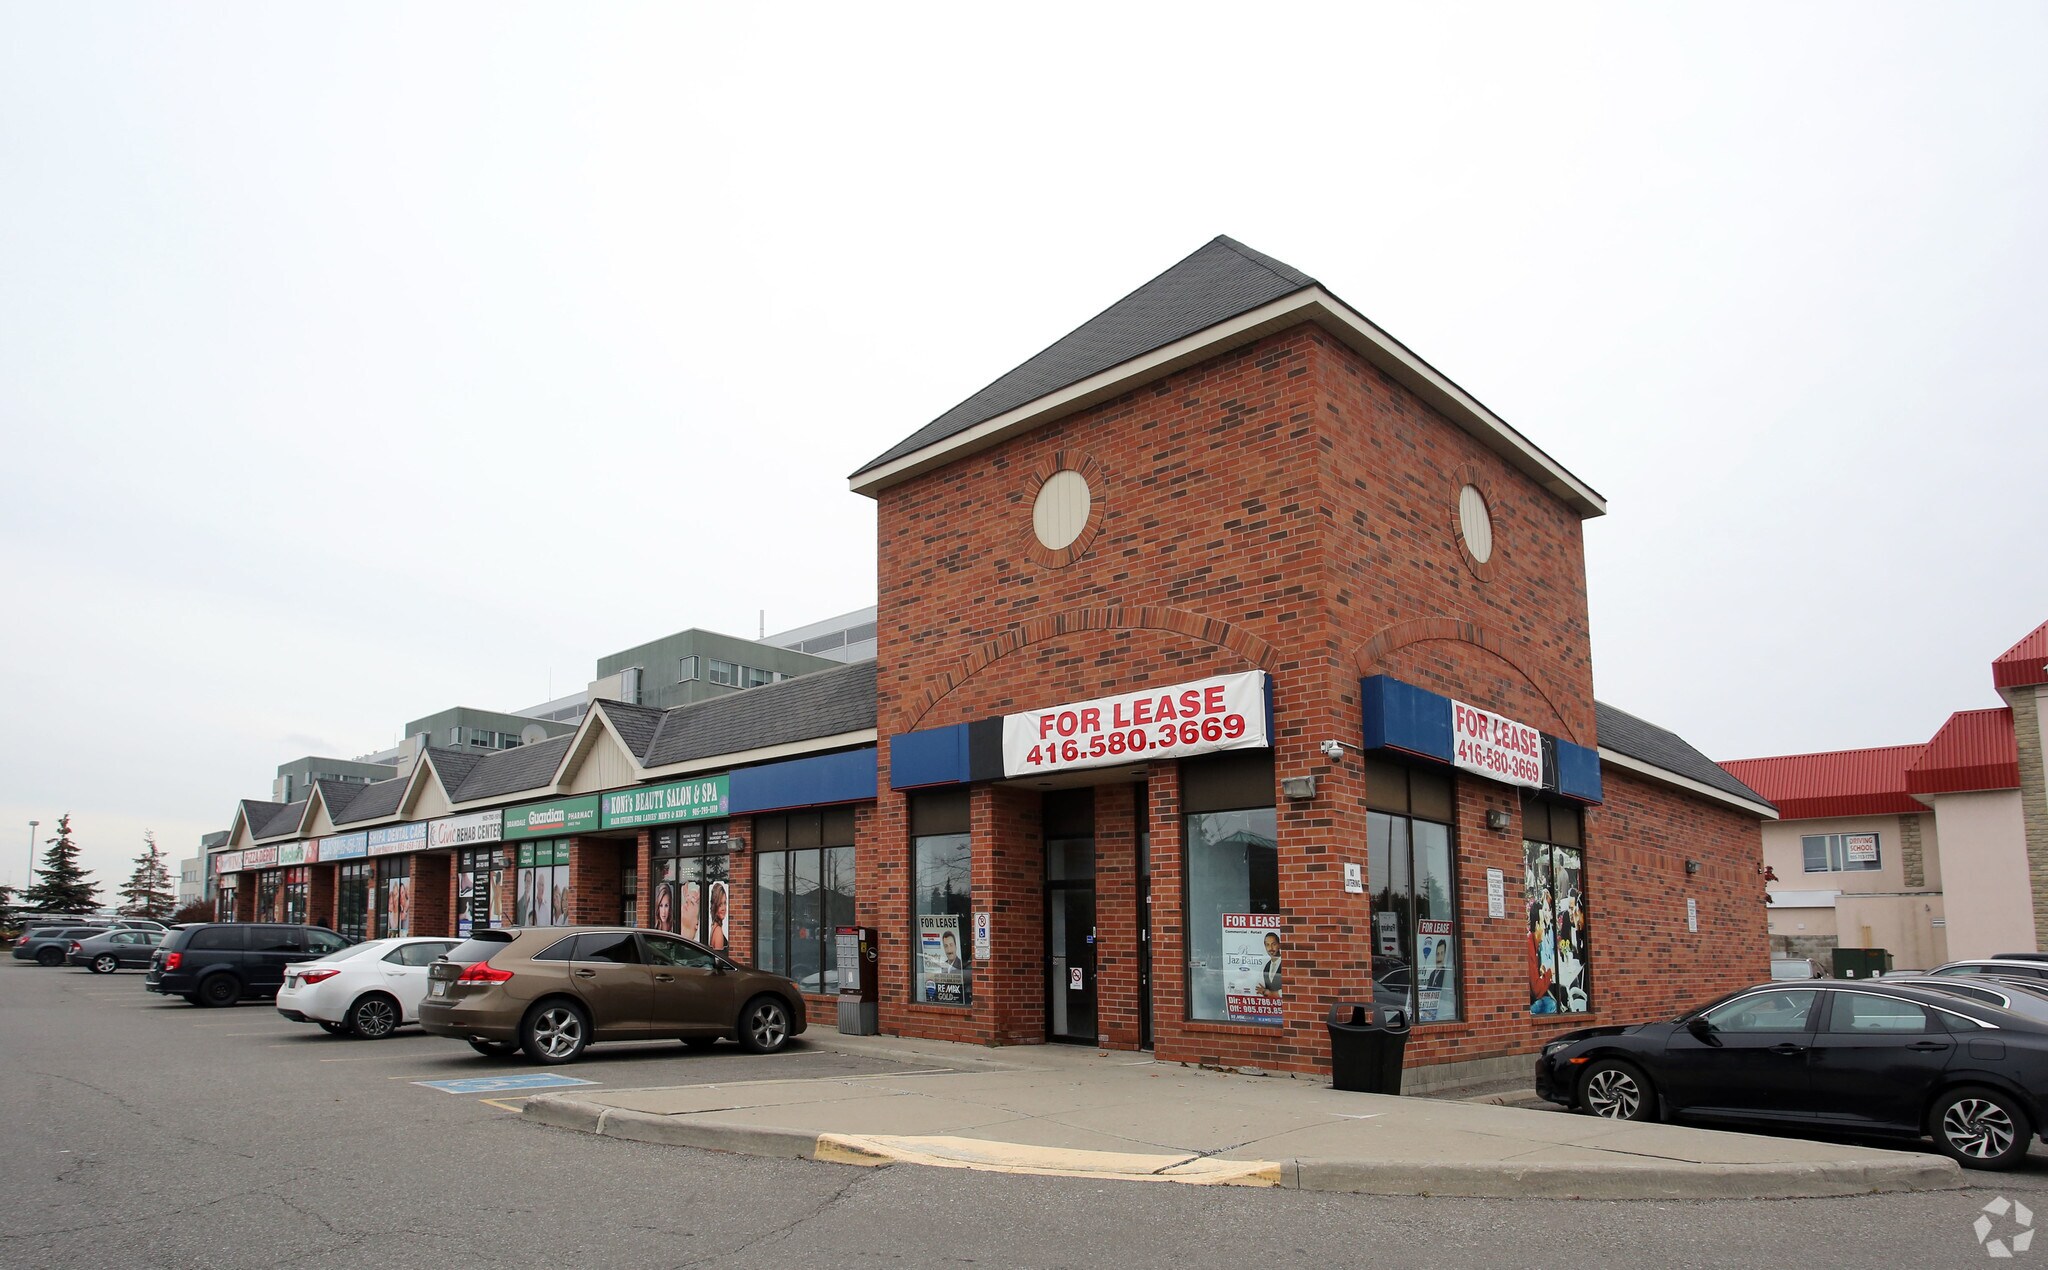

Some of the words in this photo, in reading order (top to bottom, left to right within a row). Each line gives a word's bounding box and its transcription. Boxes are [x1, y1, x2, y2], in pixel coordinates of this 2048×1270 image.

[1039, 708, 1100, 740] FOR
[1114, 685, 1226, 728] LEASE
[1026, 713, 1246, 766] 416.580.3669
[1456, 704, 1489, 742] FOR
[1493, 719, 1538, 758] LEASE
[1458, 740, 1539, 782] 416-580-3669
[635, 790, 664, 811] BEAUTY
[666, 786, 691, 808] SALON
[694, 785, 700, 804] &
[702, 782, 717, 803] SPA
[528, 808, 565, 825] Guardian
[568, 810, 594, 820] PHARMACY
[658, 811, 670, 820] MEN'S
[671, 810, 675, 818] &
[388, 826, 408, 841] DENTAL
[410, 822, 426, 839] CARE
[439, 822, 456, 844] Civic
[456, 826, 476, 842] REHAB
[478, 823, 501, 839] CENTER
[245, 850, 258, 864] PIZZA
[260, 848, 276, 862] DEPOT
[921, 918, 934, 928] FOR
[936, 918, 957, 928] LEASE
[1226, 916, 1246, 926] FOR
[1250, 916, 1280, 927] LEASE
[1422, 922, 1433, 932] FOR
[1434, 923, 1450, 933] LEASE
[1227, 955, 1239, 964] Jaz
[1242, 956, 1263, 965] Bains
